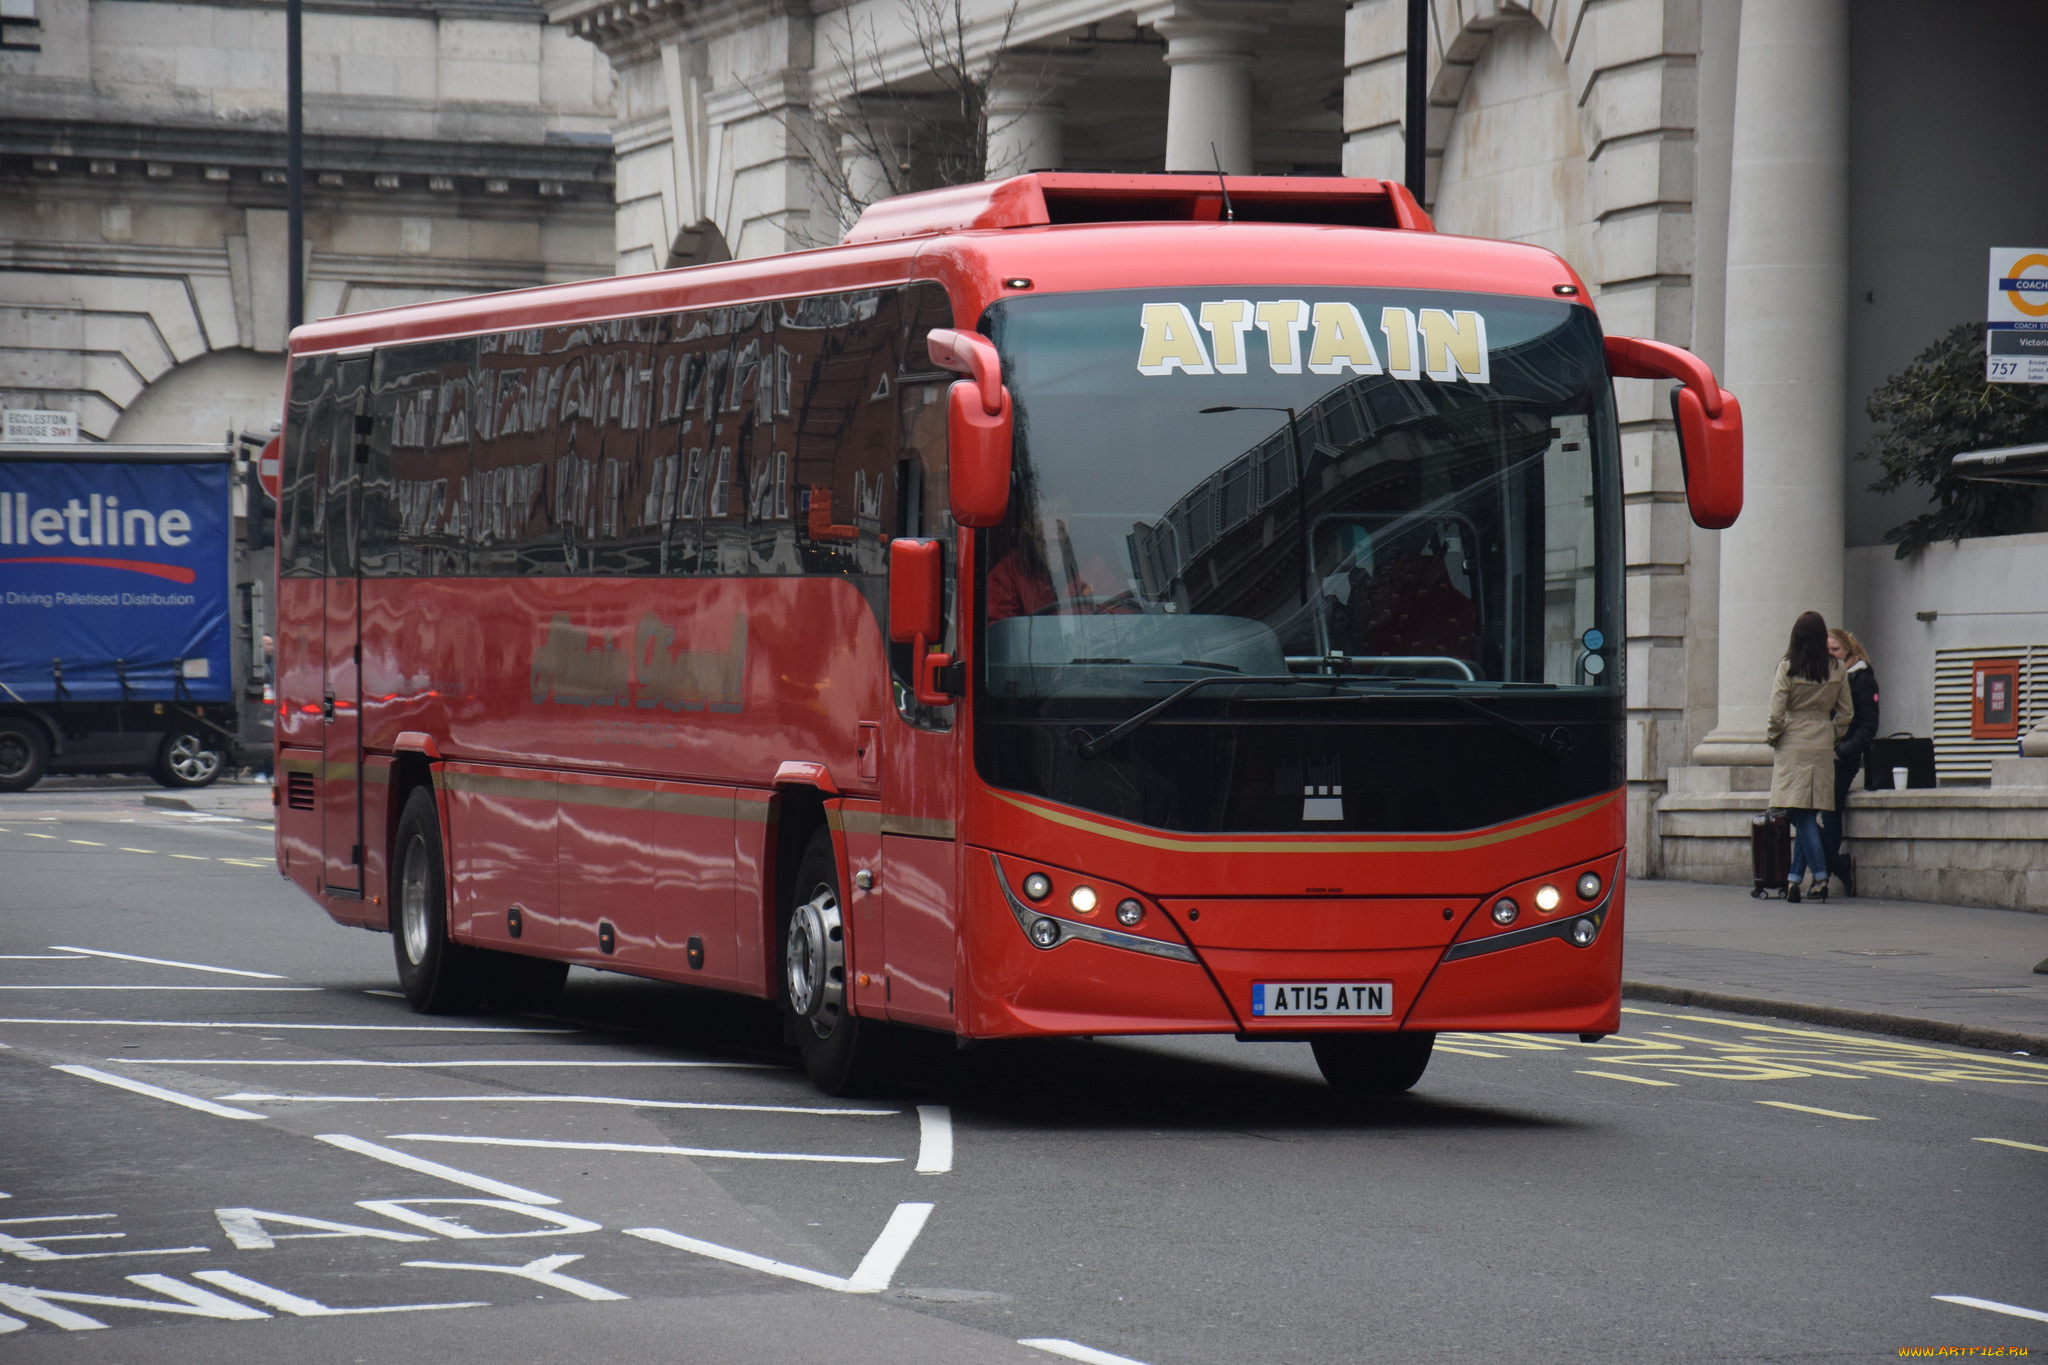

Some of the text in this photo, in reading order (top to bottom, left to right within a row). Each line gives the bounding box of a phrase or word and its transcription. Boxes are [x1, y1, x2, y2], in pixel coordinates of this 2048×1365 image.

[2015, 281, 2048, 289] COACH
[2040, 322, 2048, 330] ST
[1137, 299, 1490, 384] ATTAIN
[2019, 338, 2048, 347] Victori
[1992, 362, 2018, 375] 757
[9, 412, 67, 425] ECCLESTON
[9, 425, 72, 438] BRIDGE SW1
[6, 591, 195, 608] Driving Palletised Distribution
[1274, 986, 1383, 1010] AT15 ATN
[0, 1194, 602, 1262] EAD
[0, 1253, 631, 1335] NLY
